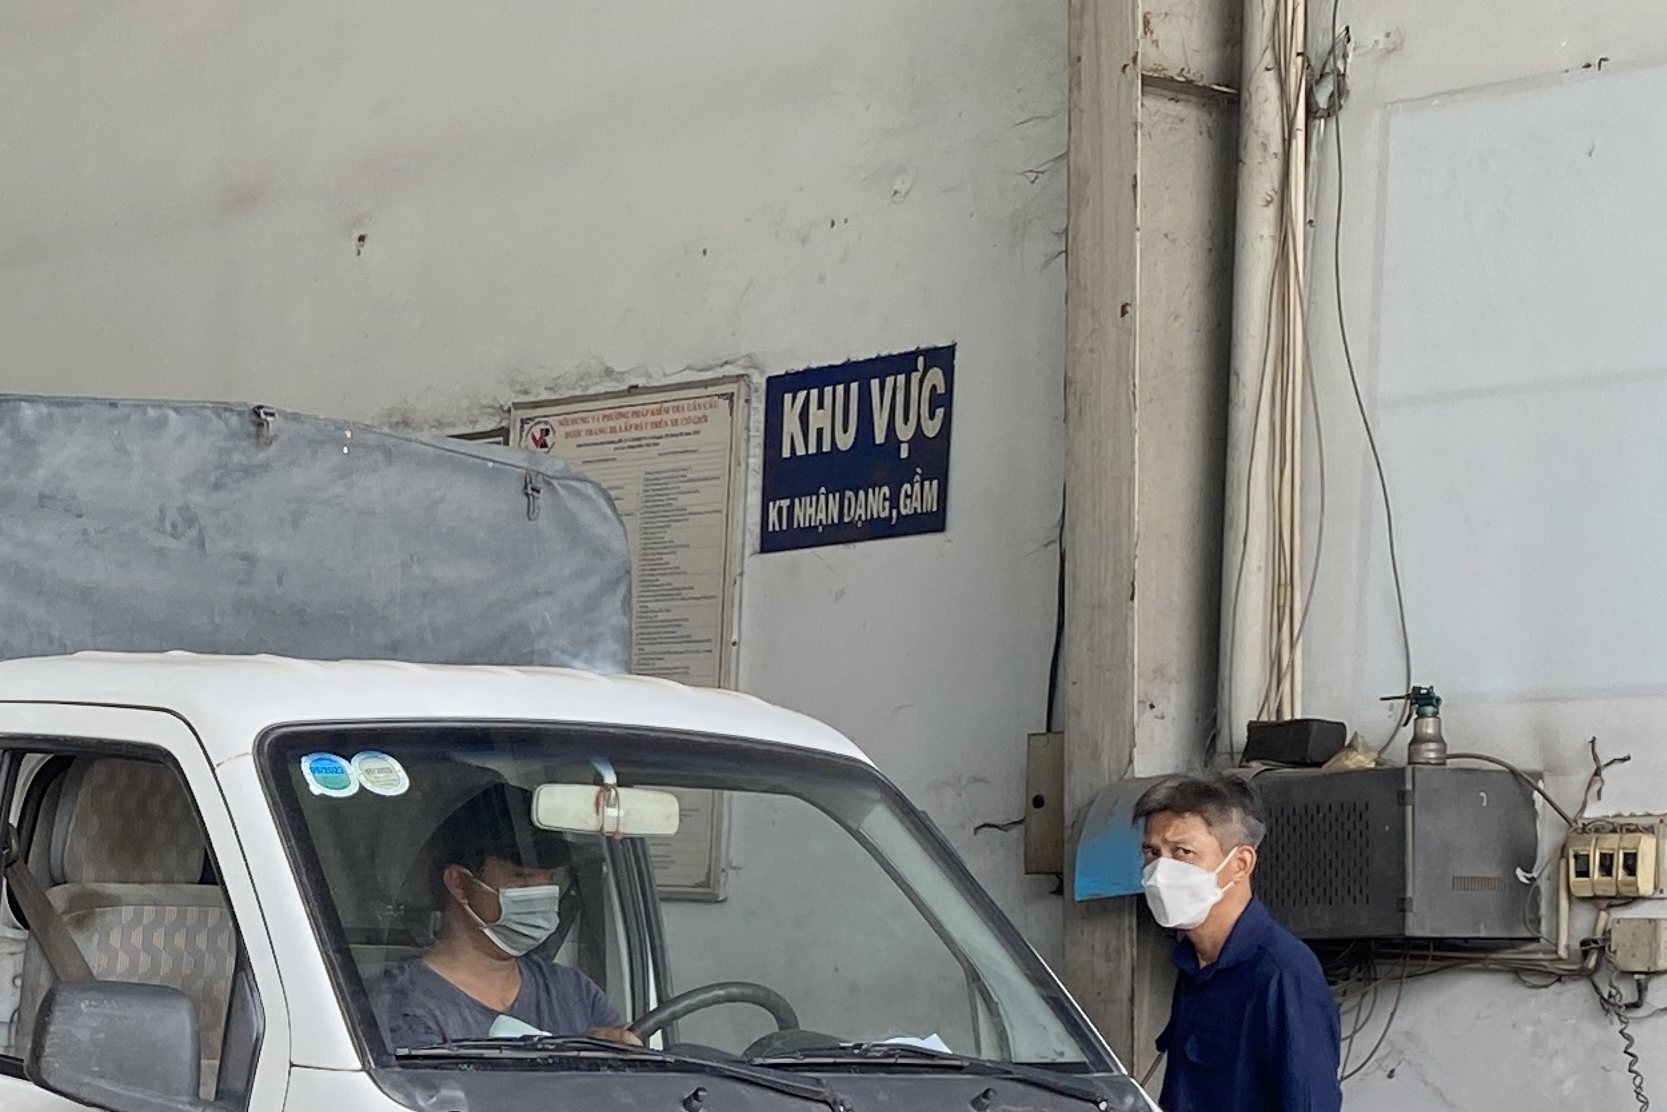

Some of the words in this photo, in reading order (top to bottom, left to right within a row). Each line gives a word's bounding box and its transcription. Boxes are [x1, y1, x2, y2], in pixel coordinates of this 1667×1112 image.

[782, 381, 859, 459] KHU
[768, 499, 790, 532] KT
[793, 486, 840, 533] NHẬN
